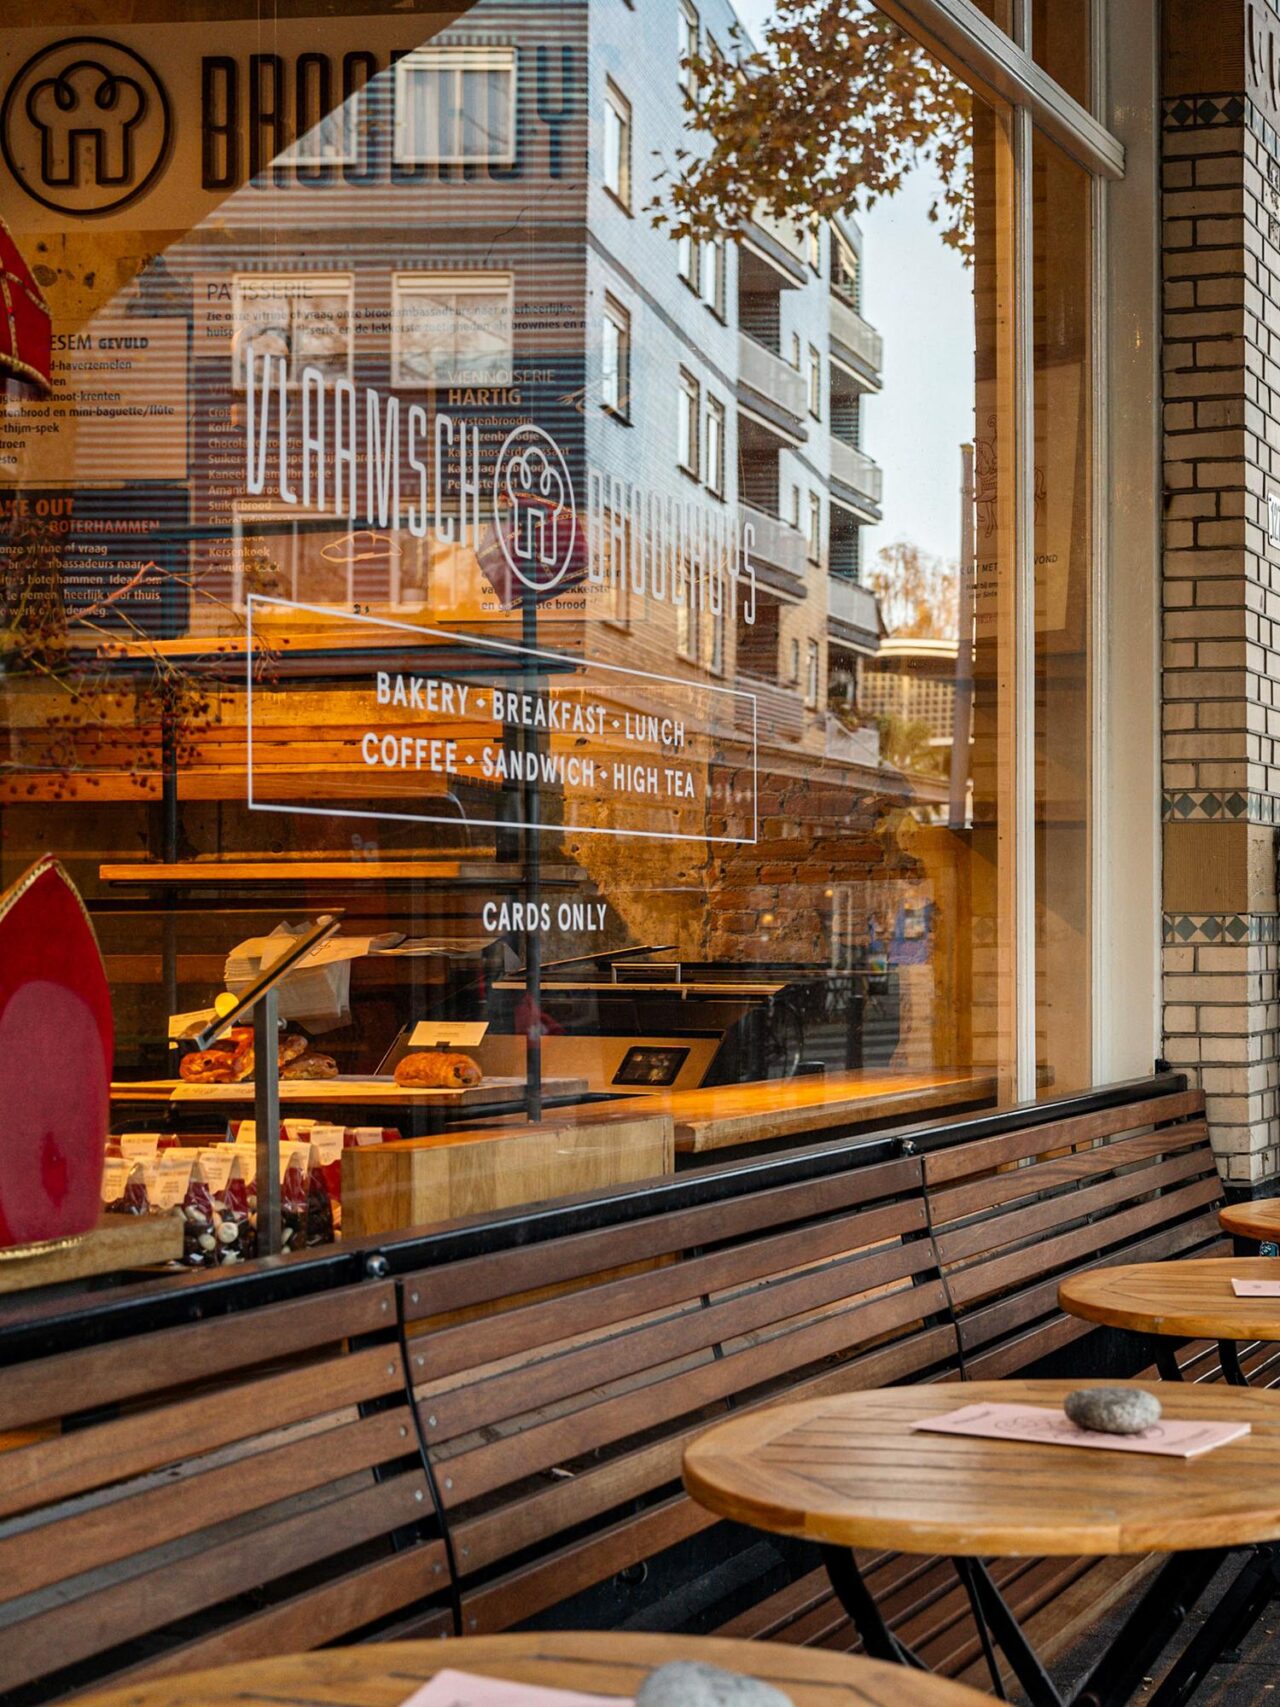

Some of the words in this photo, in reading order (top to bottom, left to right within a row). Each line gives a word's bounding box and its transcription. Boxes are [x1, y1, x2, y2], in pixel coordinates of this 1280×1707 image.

[511, 320, 560, 331] brownies
[50, 334, 92, 350] ESEM
[98, 337, 149, 350] GEVULD
[50, 358, 132, 372] d-haverzemelen
[448, 369, 557, 384] VIENNOISERIE
[448, 388, 522, 406] HARTIG
[53, 409, 65, 417] en
[0, 439, 26, 449] troen
[246, 346, 481, 553] VLAAMSCH
[35, 498, 74, 516] OUT
[50, 519, 160, 534] BOTERHAMMEN
[78, 545, 108, 556] vraag
[555, 599, 587, 610] brood
[376, 671, 469, 716] BAKERY
[492, 690, 606, 736] BREAKFAST
[625, 712, 685, 748] LUNCH
[362, 732, 458, 775] COFFEE
[482, 746, 595, 788] SANDWICH
[613, 762, 658, 795] HIGH
[664, 769, 695, 799] TEA
[482, 901, 551, 932] CARDS
[557, 903, 608, 932] ONLY
